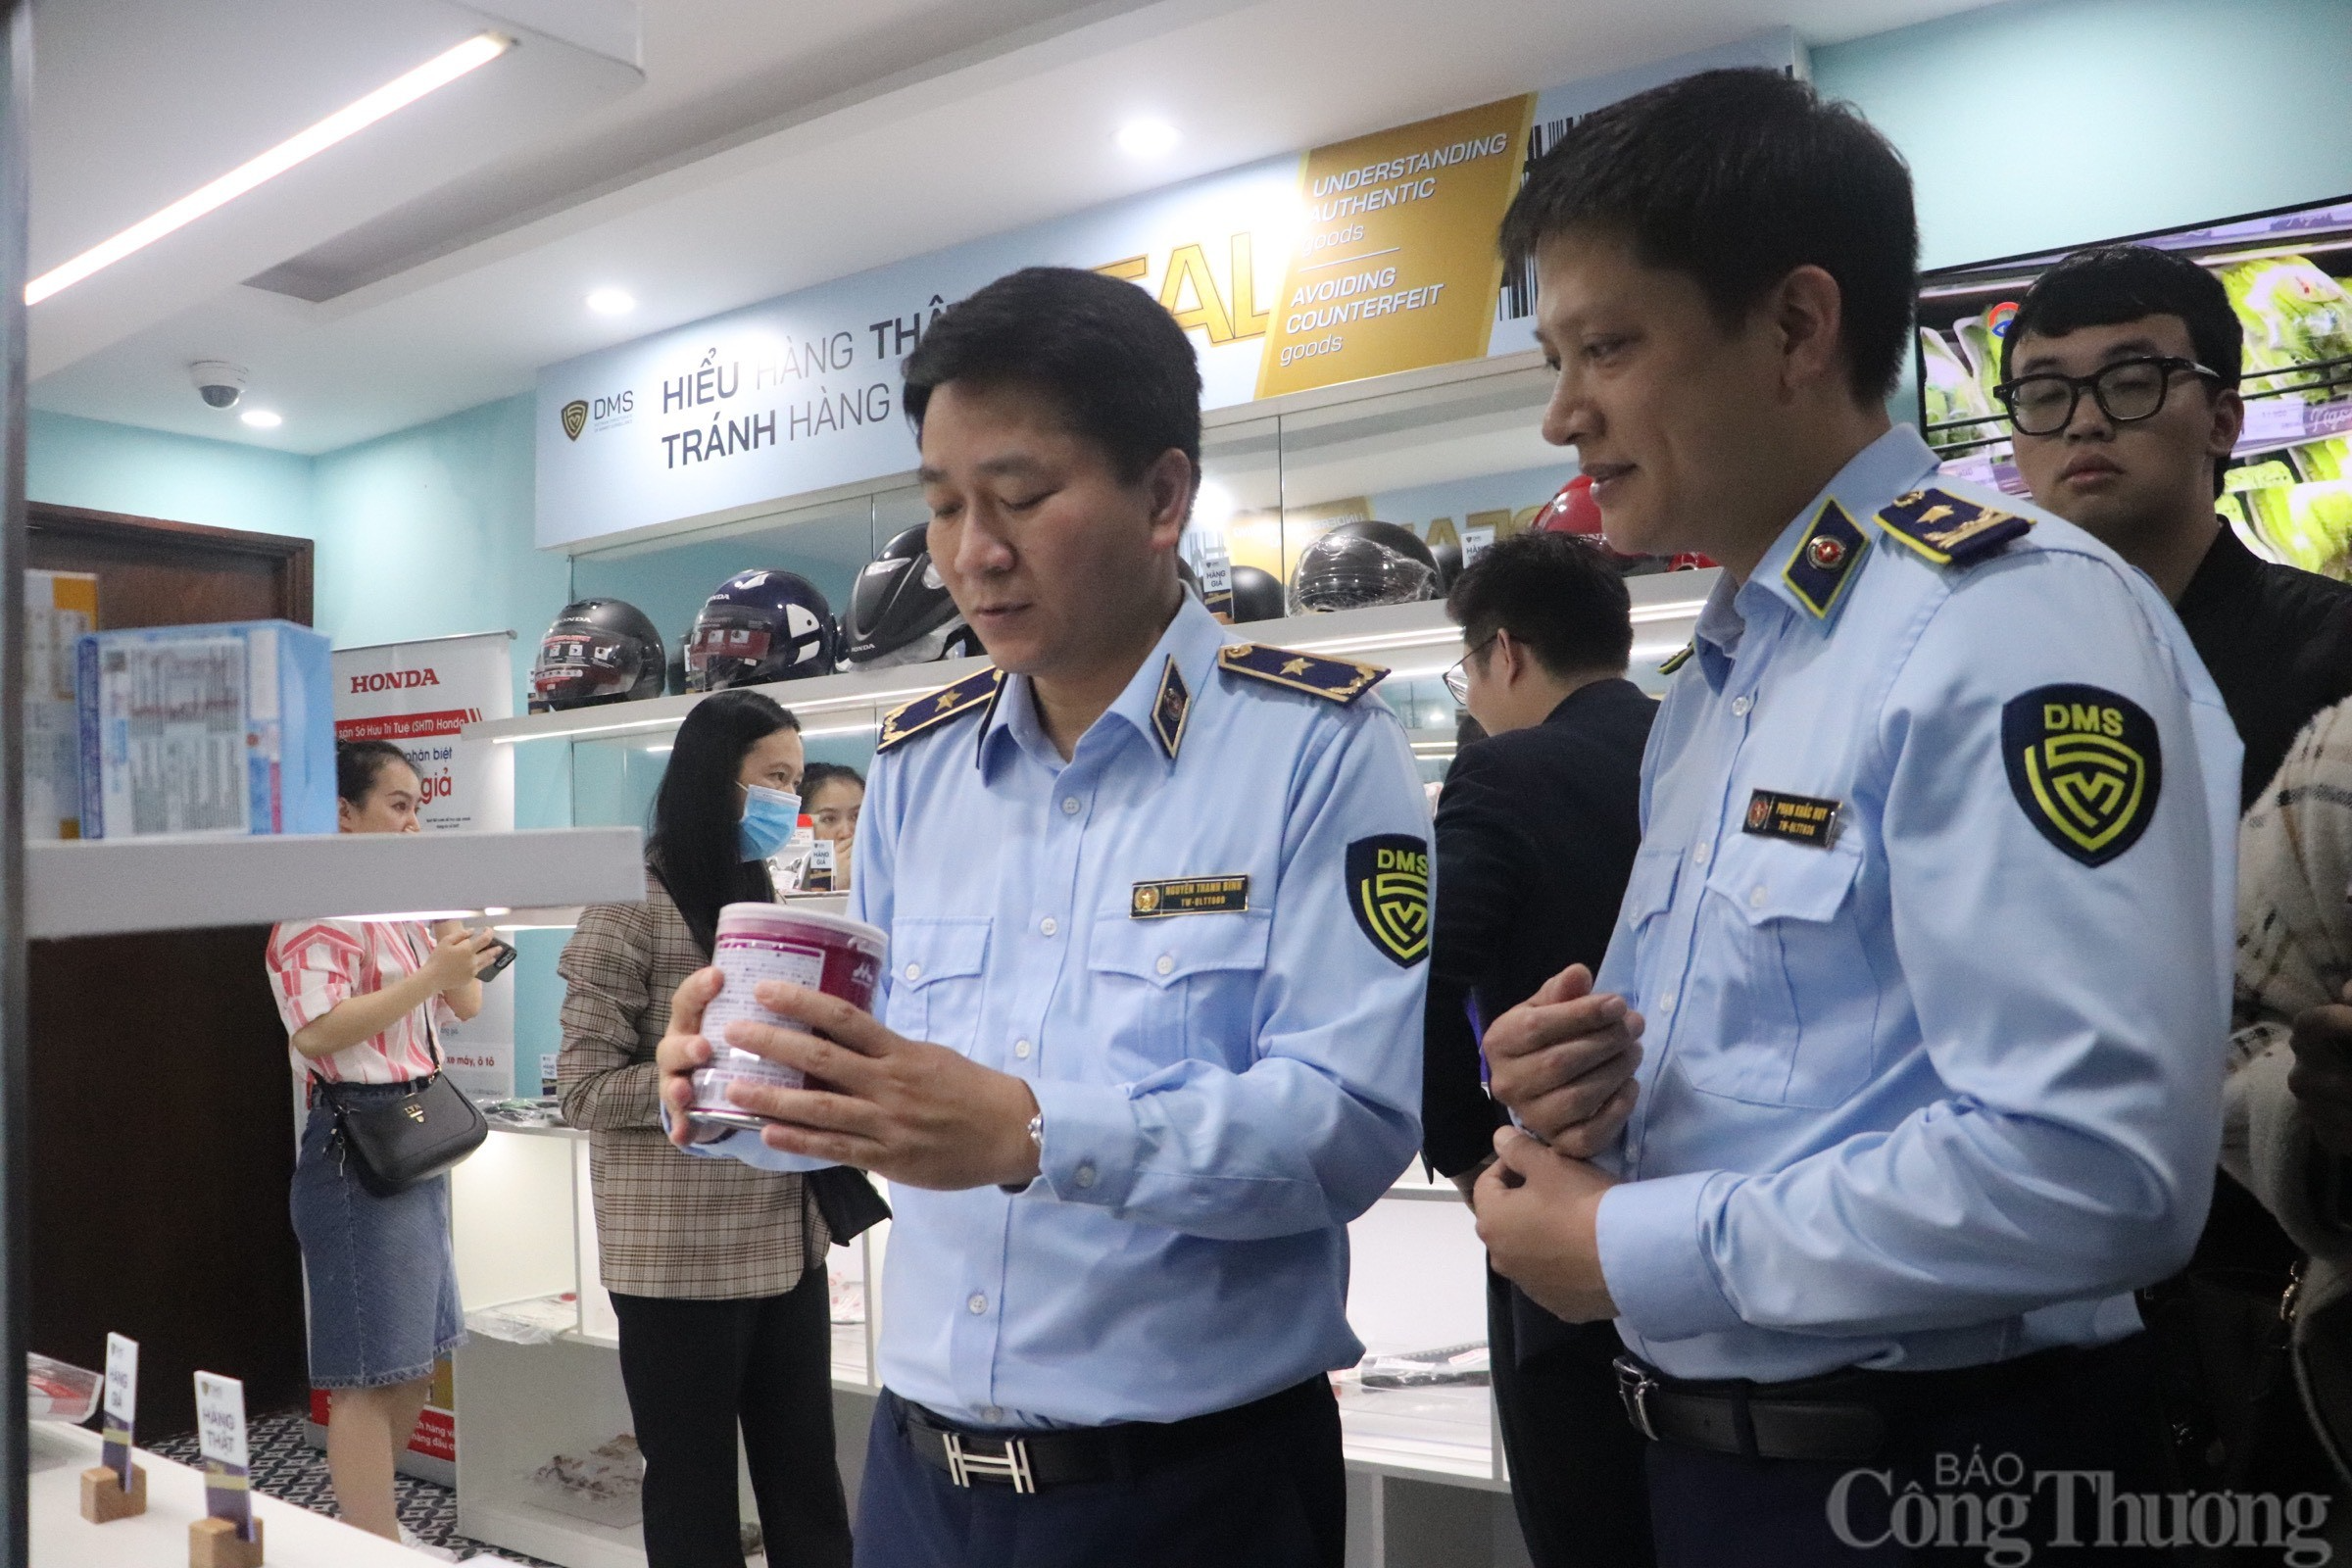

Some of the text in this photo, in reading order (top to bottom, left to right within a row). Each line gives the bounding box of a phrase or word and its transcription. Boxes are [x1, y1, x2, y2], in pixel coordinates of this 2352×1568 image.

[1312, 133, 1508, 198] UNDERSTANDING
[1307, 177, 1437, 223] AUTHENTIC
[1301, 223, 1364, 257] goods
[1291, 267, 1396, 308] AVOIDING
[1286, 284, 1445, 334] COUNTERFEIT
[1280, 334, 1344, 368] goods
[662, 347, 739, 415] HIỂU
[757, 331, 854, 390] HÀNG
[594, 390, 634, 420] DMS
[662, 382, 891, 468] TRÁNH HÀNG
[351, 667, 440, 694] HONDA
[2043, 703, 2124, 736] DMS
[420, 767, 452, 805] giả
